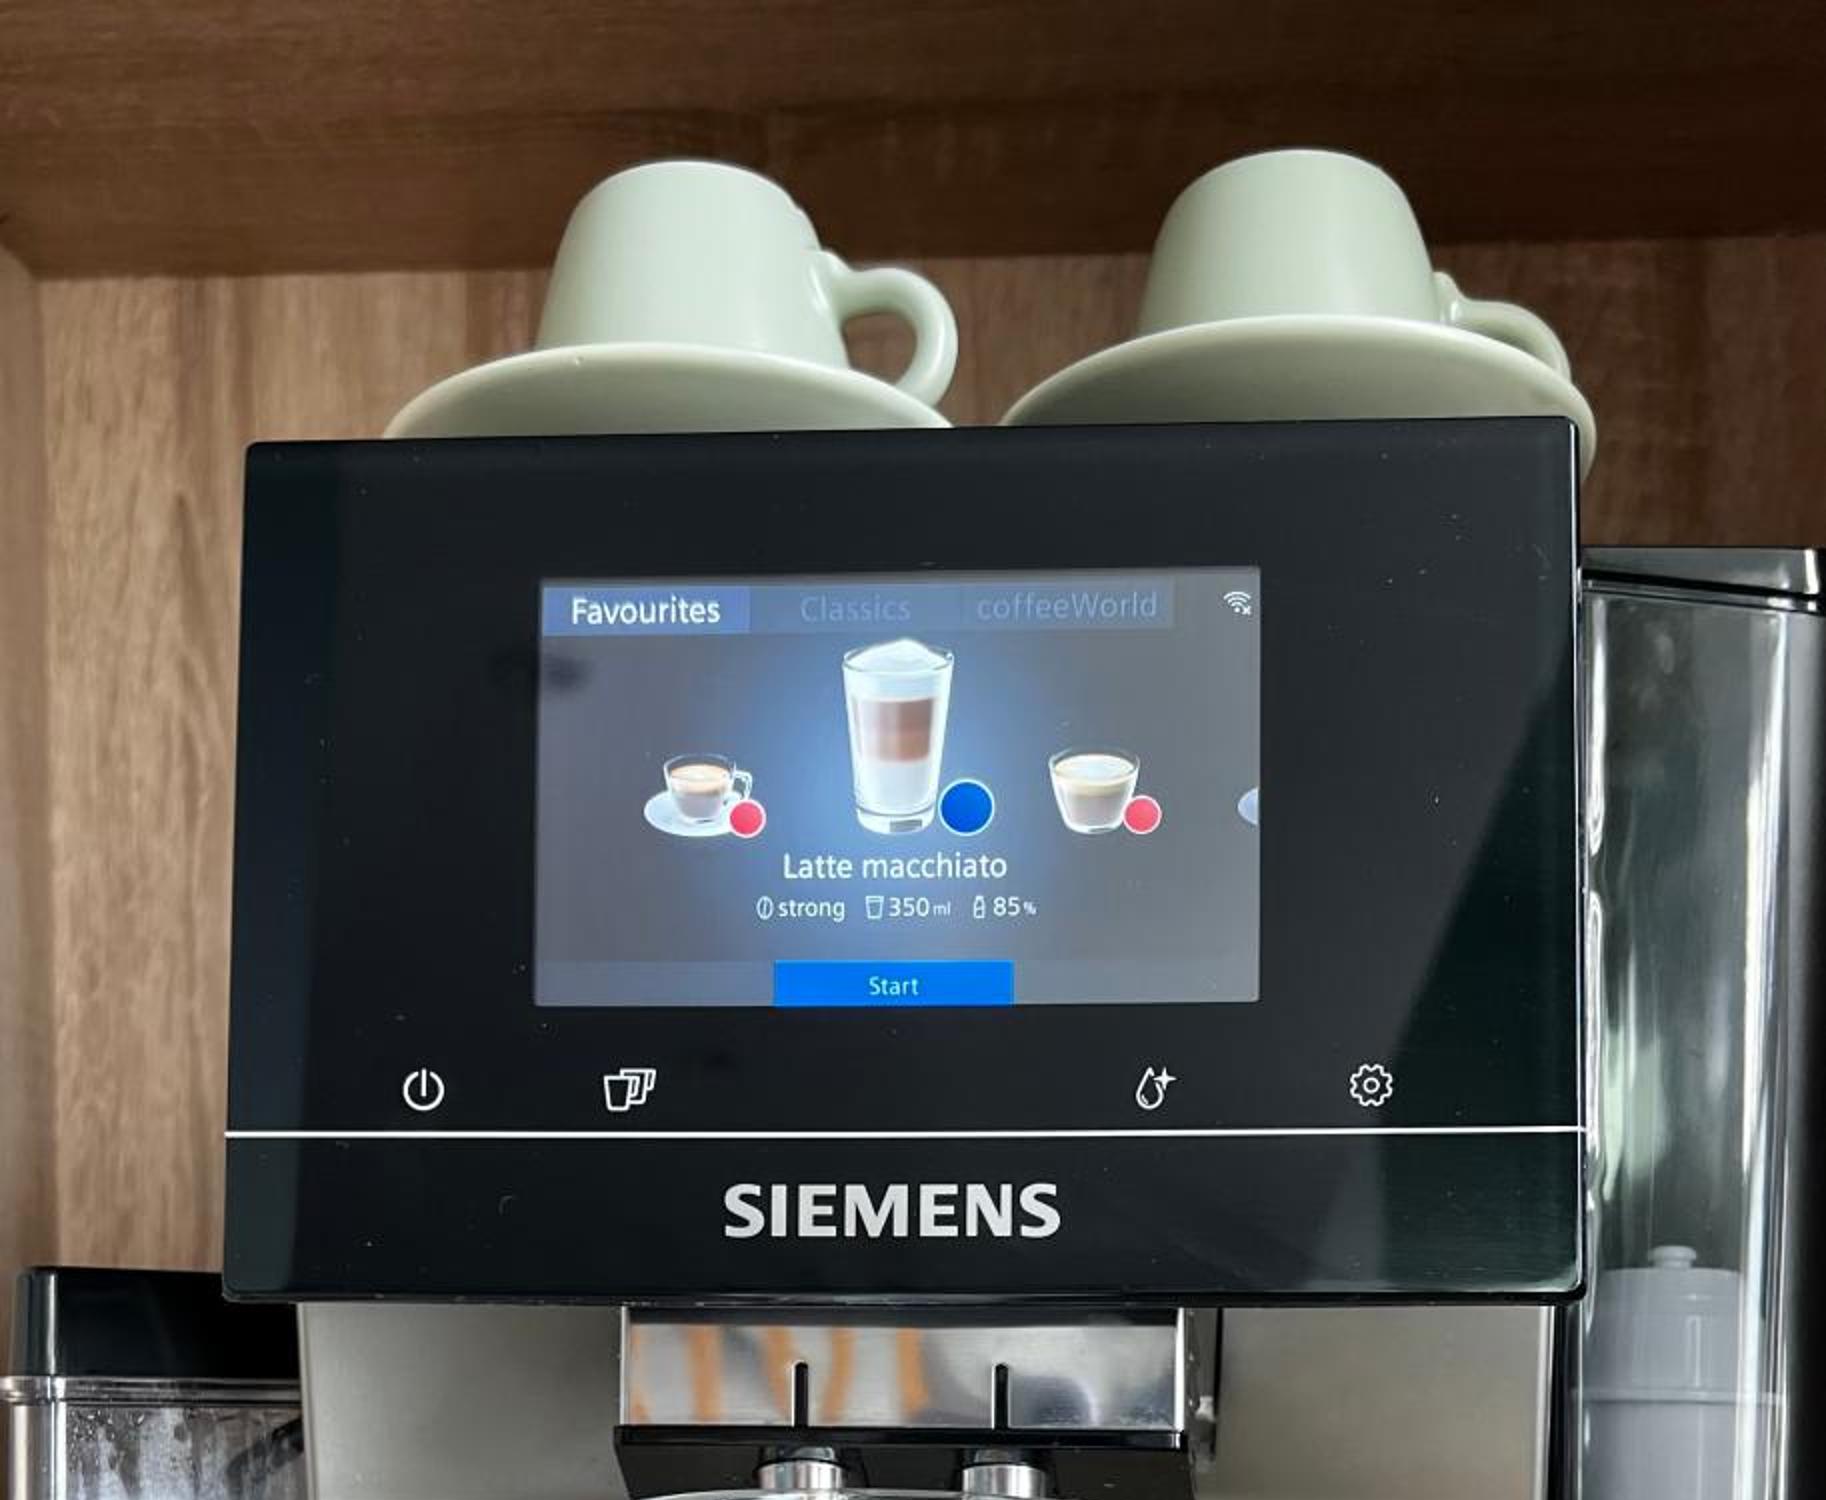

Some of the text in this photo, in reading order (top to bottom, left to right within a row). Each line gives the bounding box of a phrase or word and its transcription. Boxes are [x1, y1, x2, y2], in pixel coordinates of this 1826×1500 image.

[571, 596, 721, 625] Favourites
[800, 596, 912, 622] Classics
[977, 591, 1158, 620] coffeeWorld
[783, 852, 1008, 879] Latte macchiato
[777, 898, 845, 923] strong
[868, 975, 919, 996] Start
[723, 1182, 1062, 1239] SIEMENS
